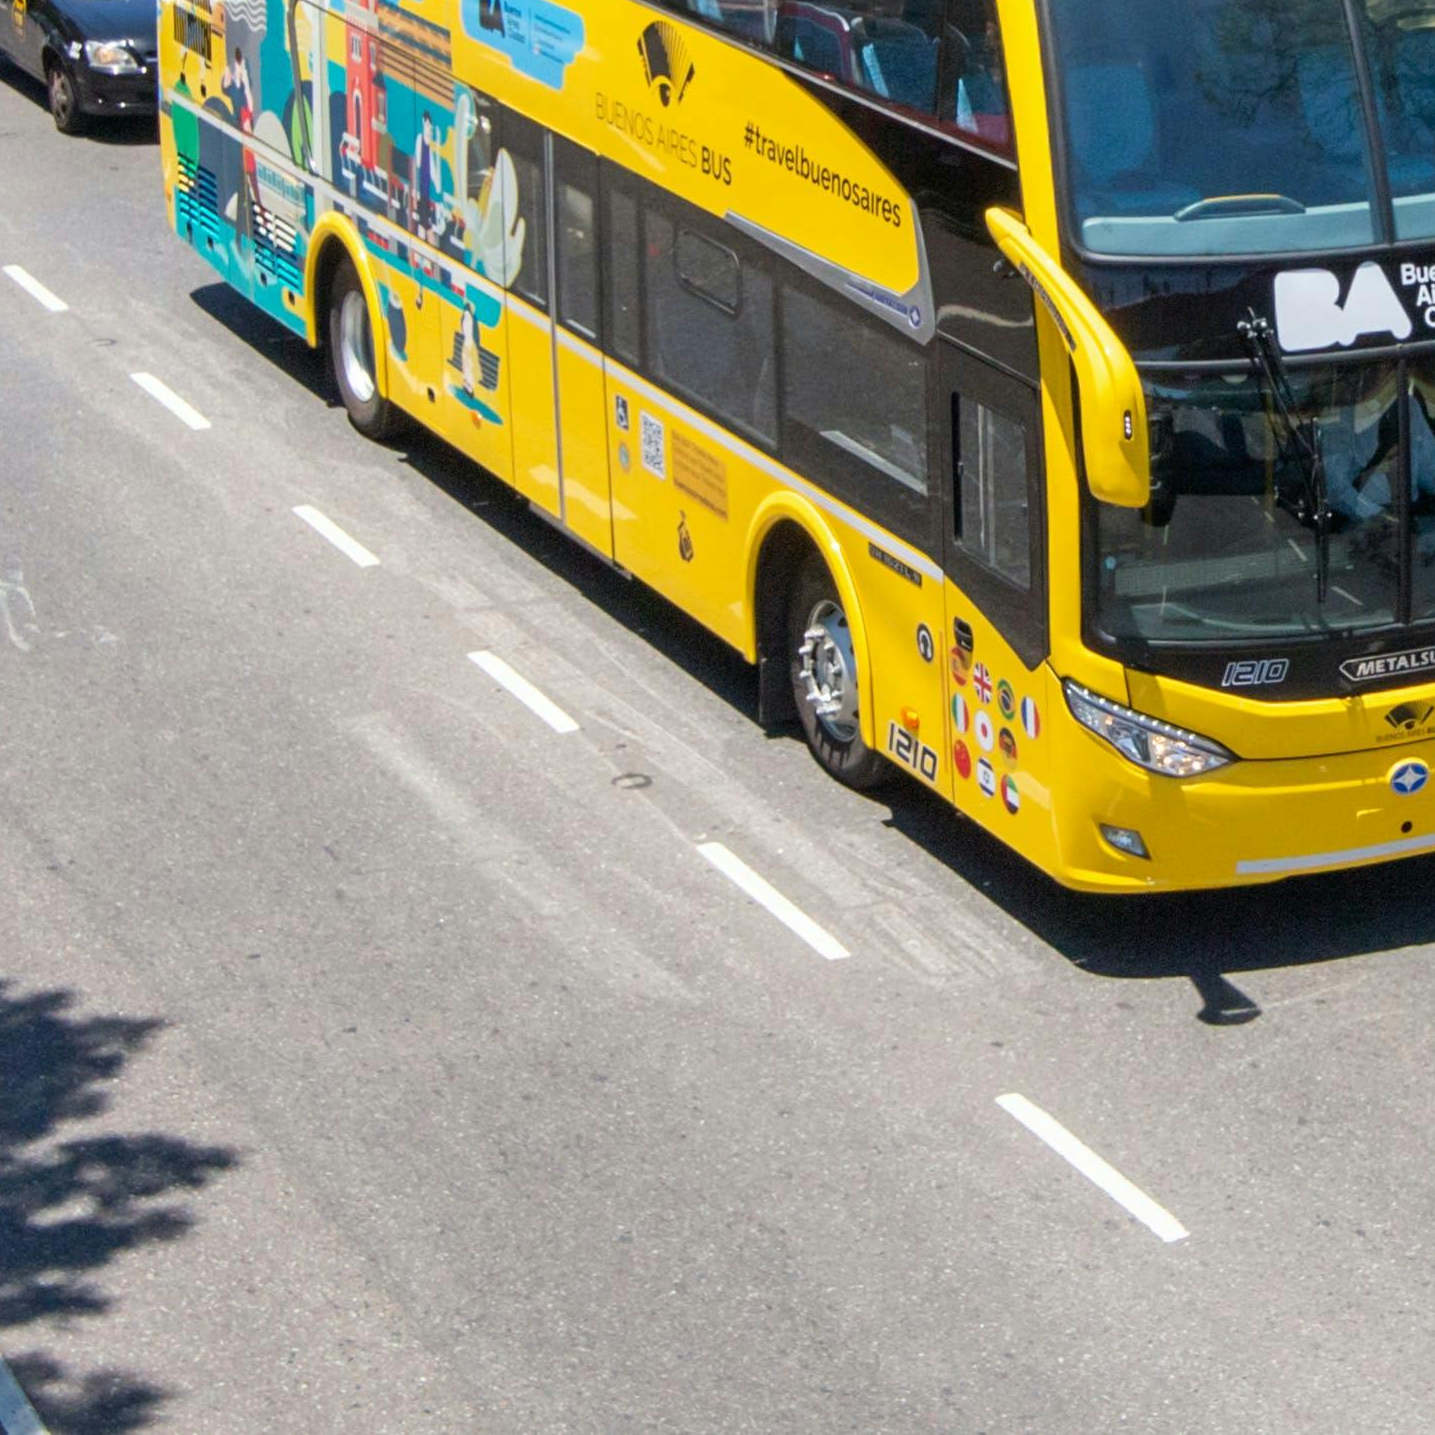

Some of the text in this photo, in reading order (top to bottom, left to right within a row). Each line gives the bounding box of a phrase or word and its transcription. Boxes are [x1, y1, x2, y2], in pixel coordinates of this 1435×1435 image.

[596, 92, 732, 186] BUENOS AIRES BUS
[744, 120, 902, 228] #travelbuenosaires
[1274, 261, 1412, 352] BA
[1221, 658, 1290, 687] 1210
[888, 722, 938, 782] 1210
